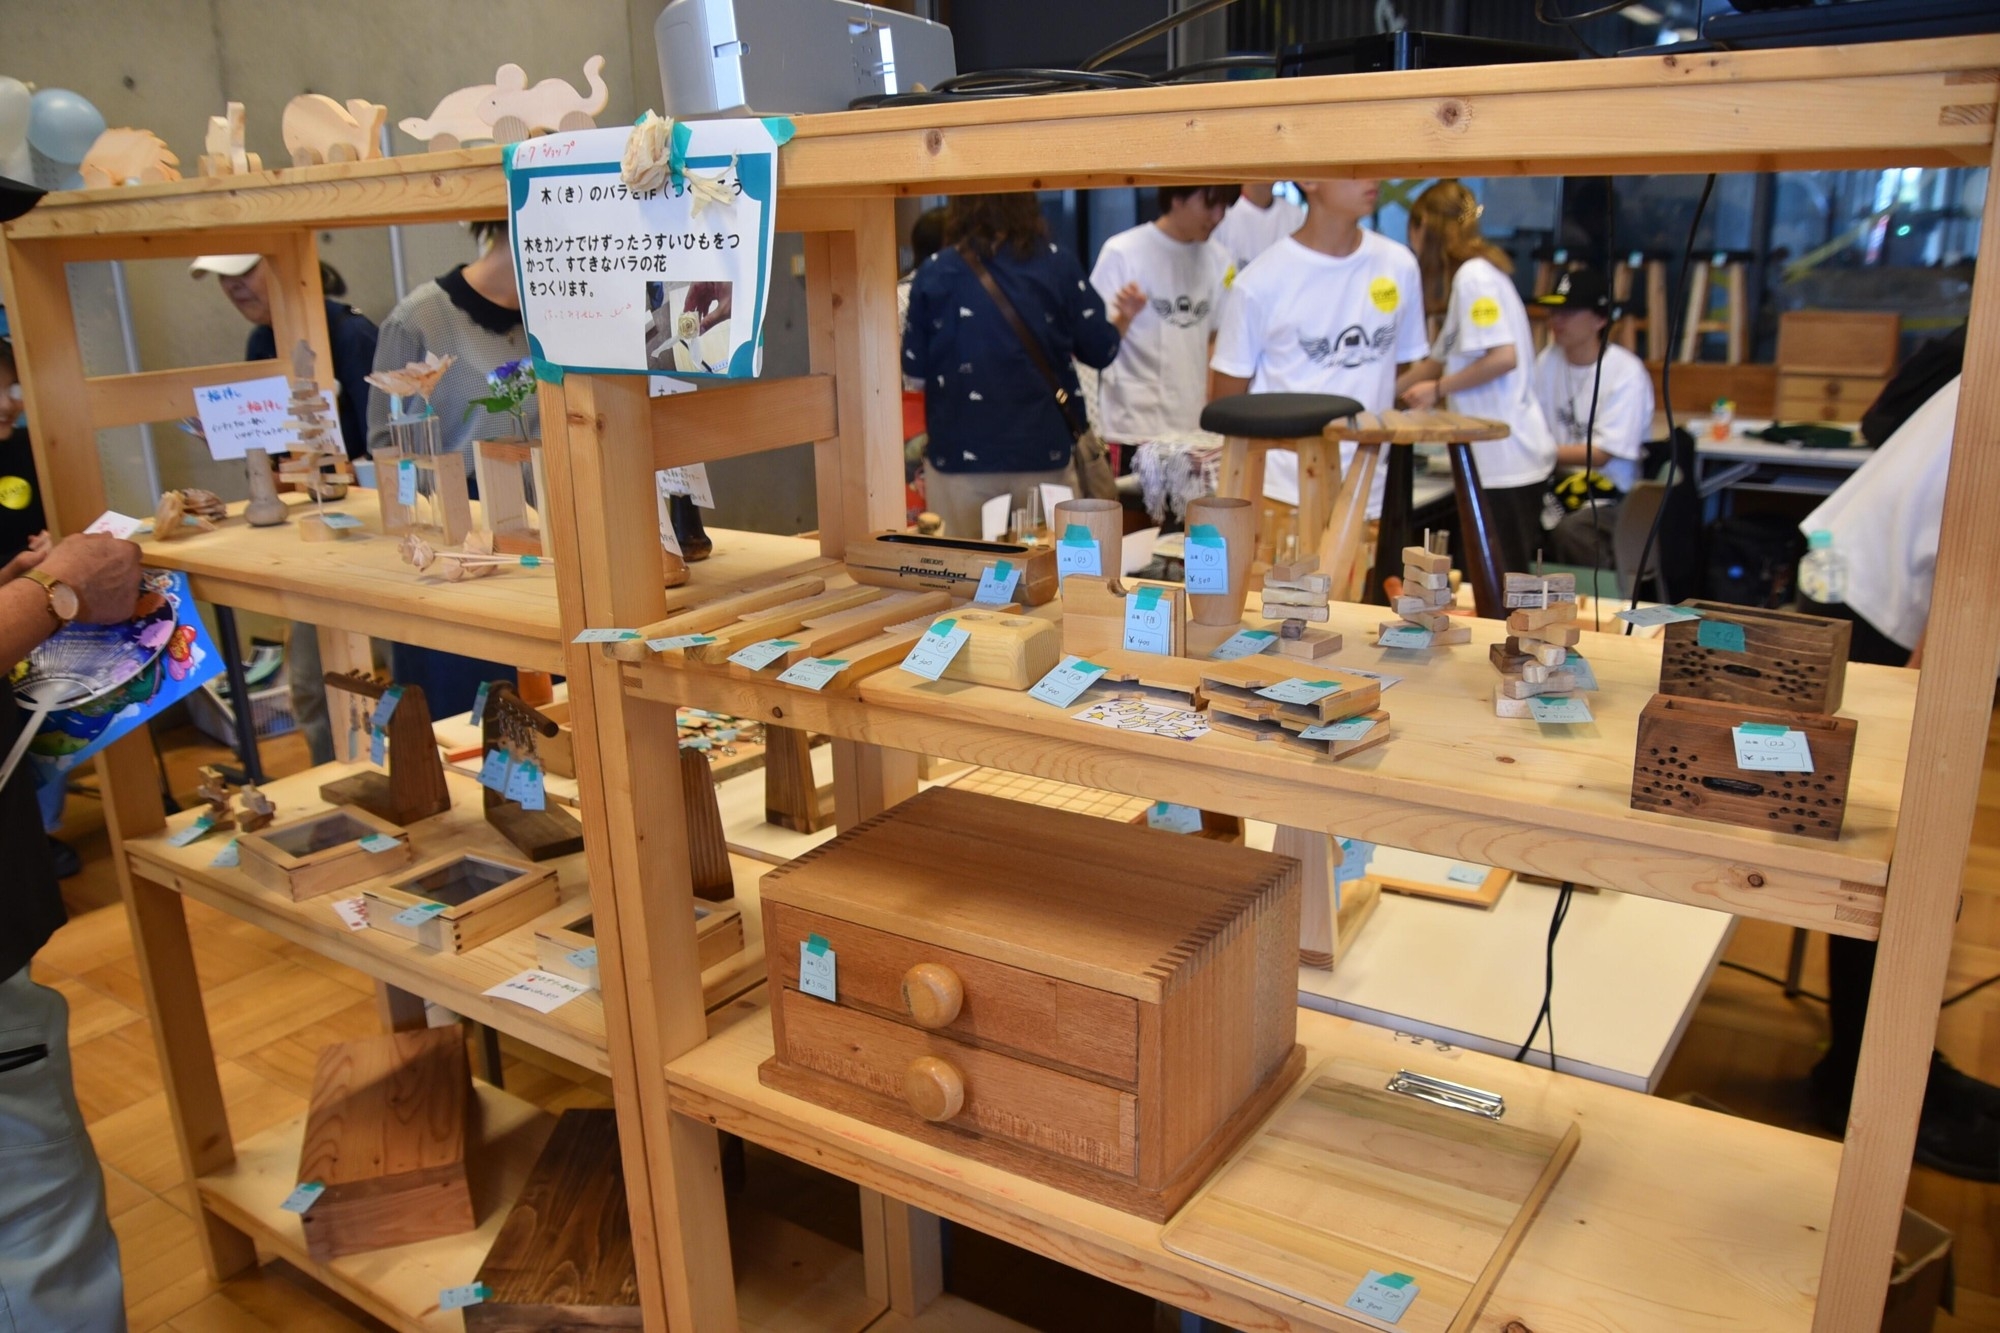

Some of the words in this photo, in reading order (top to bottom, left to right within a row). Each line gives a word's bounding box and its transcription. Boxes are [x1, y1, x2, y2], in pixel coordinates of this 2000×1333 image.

[524, 232, 741, 254] 木をカンナでけずったうすいひもをつ
[526, 253, 668, 274] かって、すてきなバラの花
[529, 279, 595, 299] をつくります。
